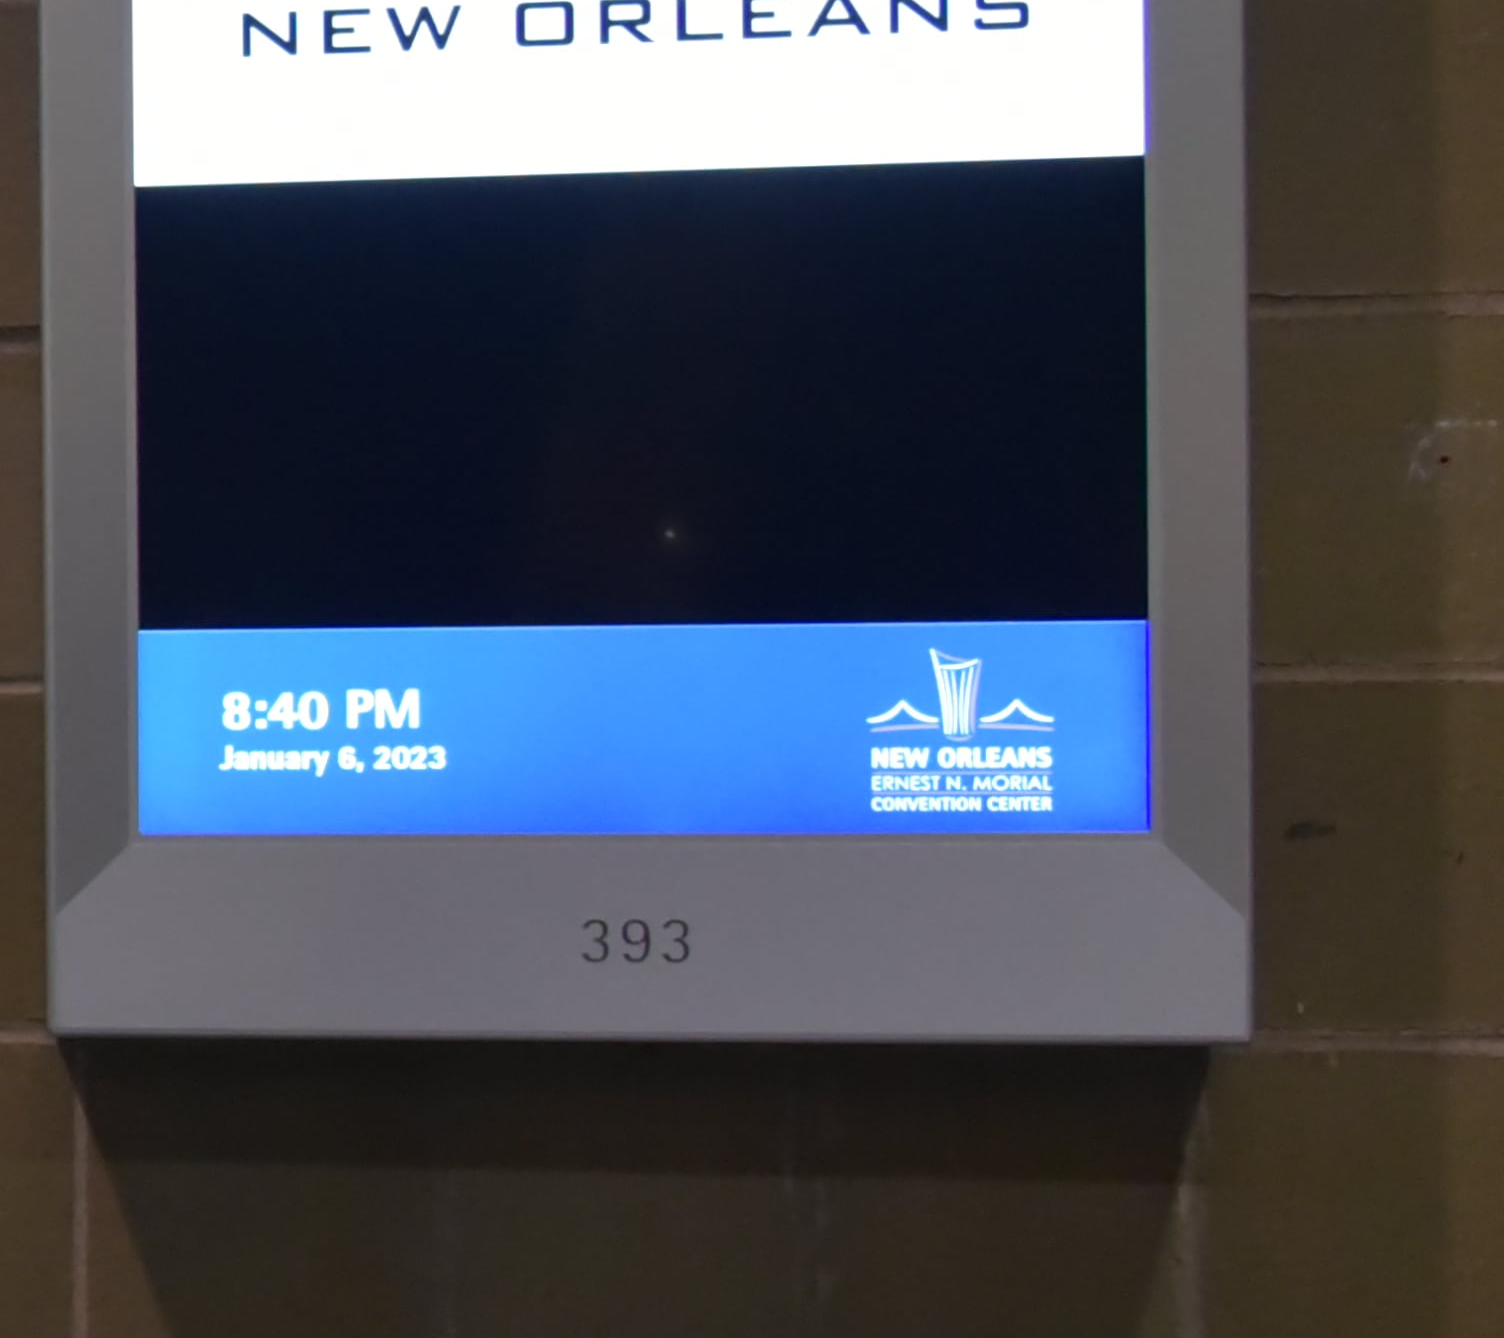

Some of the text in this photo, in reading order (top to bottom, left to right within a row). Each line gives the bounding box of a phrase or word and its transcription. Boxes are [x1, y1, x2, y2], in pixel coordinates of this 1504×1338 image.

[241, 4, 463, 58] NEW
[222, 688, 421, 732] 8:40 PM
[218, 744, 448, 778] January 6, 2023
[870, 745, 1054, 769] NEW ORLEANS
[870, 775, 1054, 792] ERNEST N. MORIAL
[870, 796, 1054, 812] CONVENTION CENTER
[581, 918, 690, 964] 393
